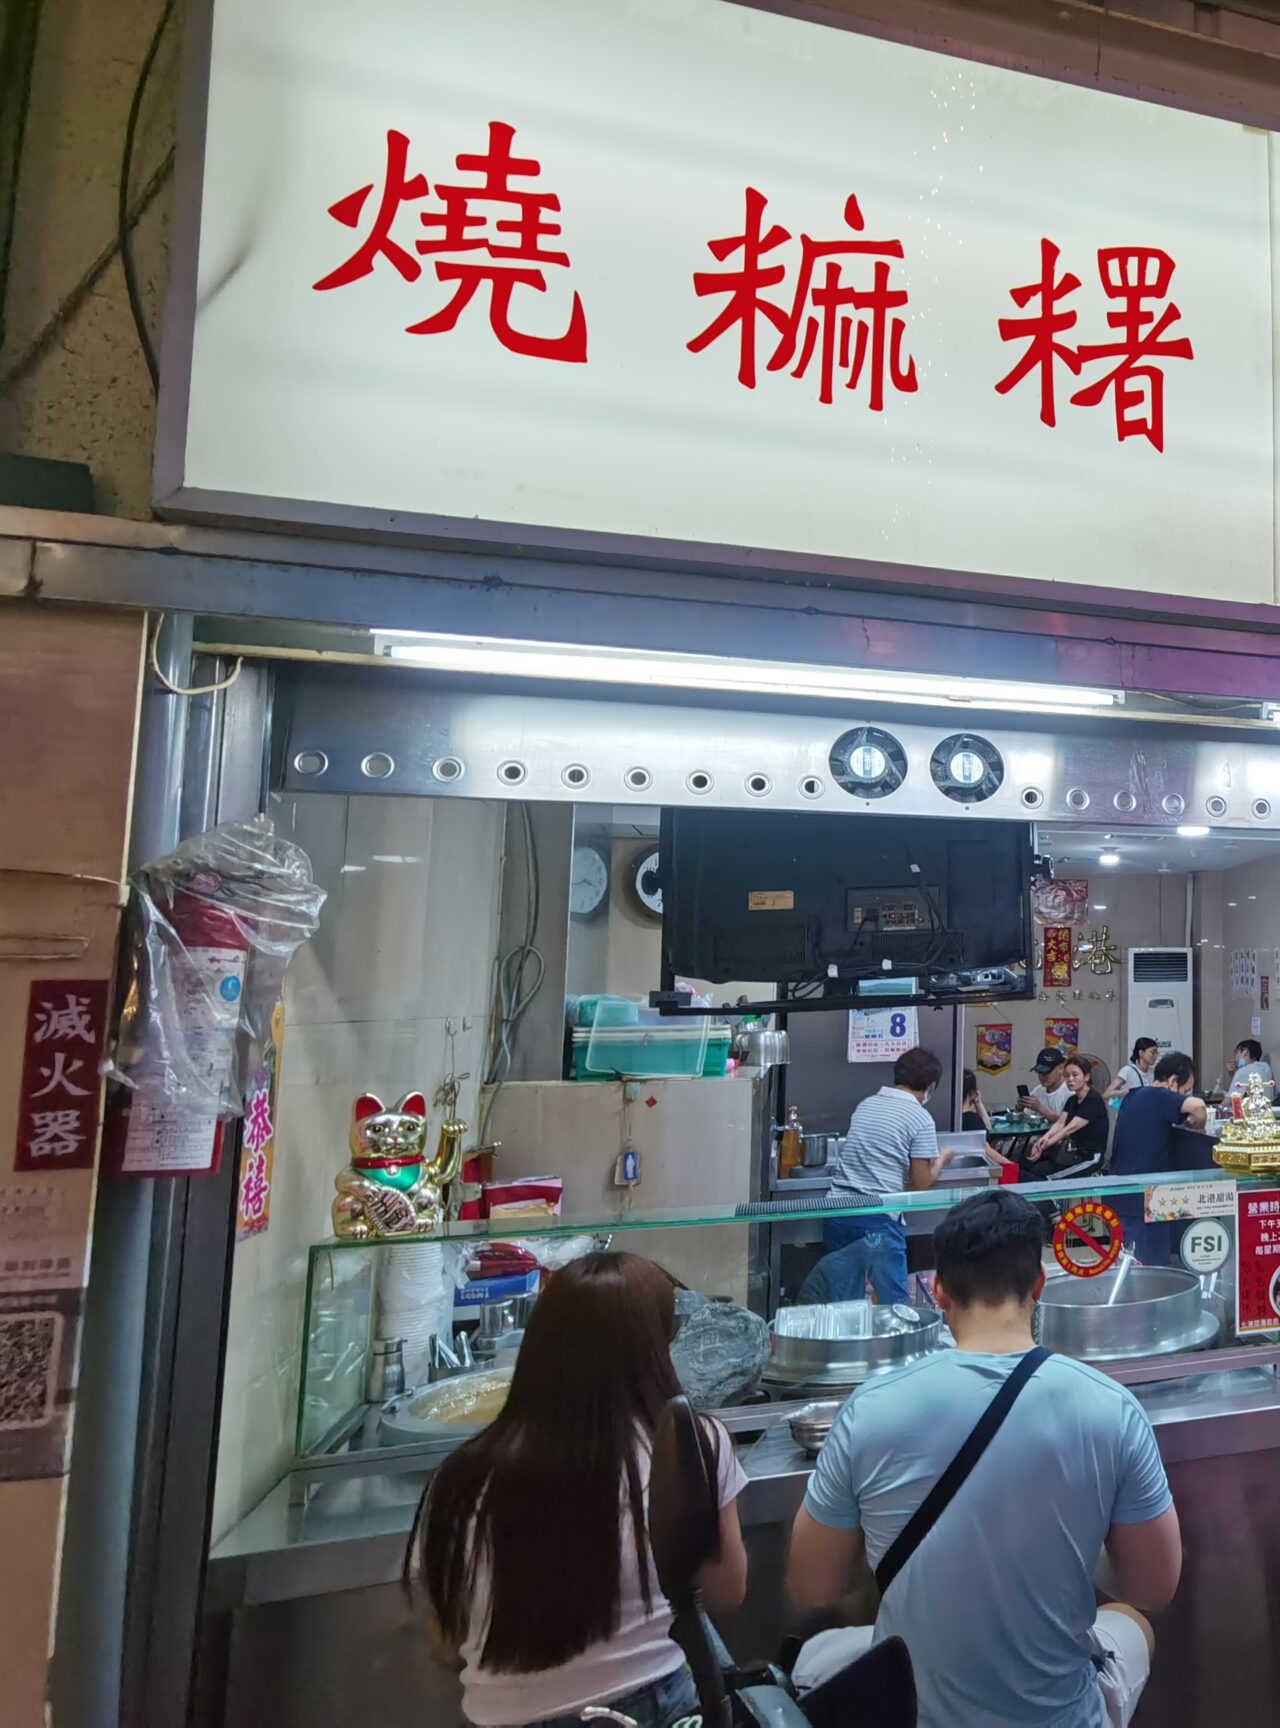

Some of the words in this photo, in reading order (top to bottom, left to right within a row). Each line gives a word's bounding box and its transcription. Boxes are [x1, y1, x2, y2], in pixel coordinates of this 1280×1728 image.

[890, 1013, 906, 1037] 8
[30, 994, 96, 1158] 滅火器
[1190, 1235, 1222, 1254] FSI
